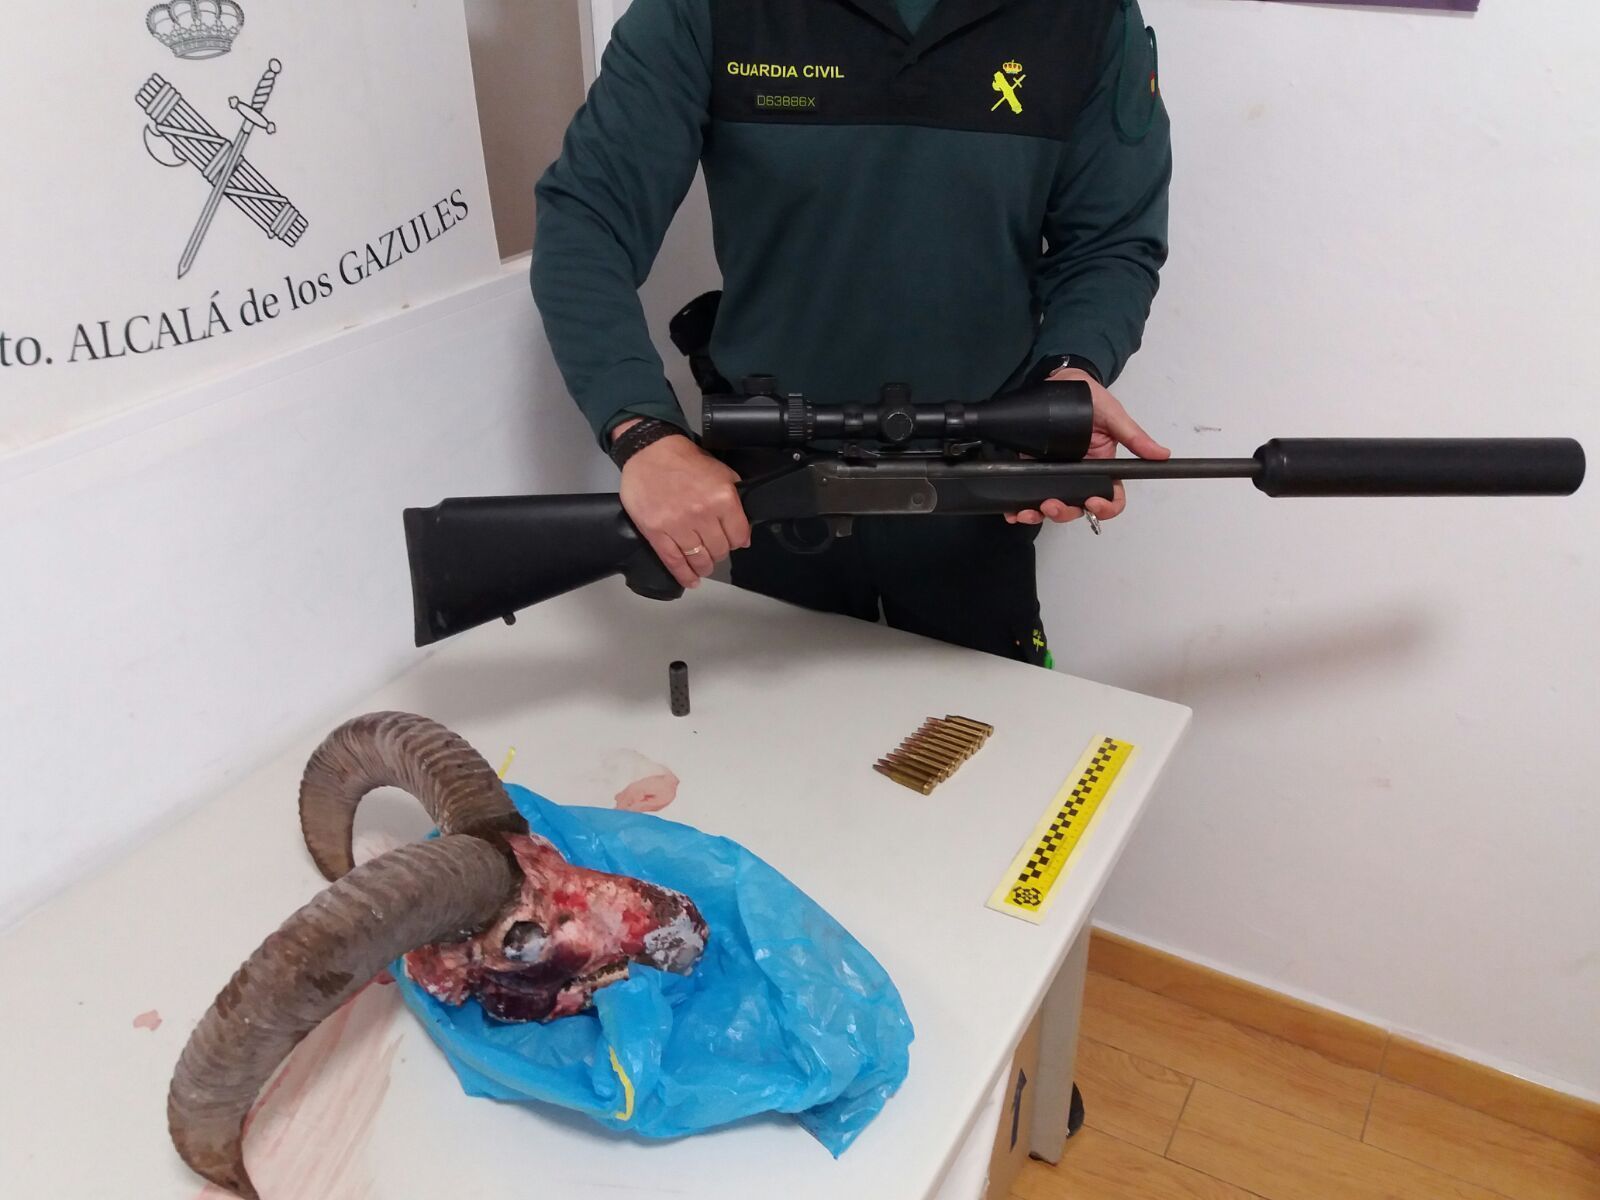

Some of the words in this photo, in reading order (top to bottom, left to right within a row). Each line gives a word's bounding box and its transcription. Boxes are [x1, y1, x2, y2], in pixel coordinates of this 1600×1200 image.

[727, 61, 798, 78] GUARDIA
[802, 65, 845, 78] CIVIL
[67, 290, 232, 363] ALCALÁ
[239, 288, 281, 327] de
[284, 272, 334, 310] los
[338, 189, 470, 286] GAZULES
